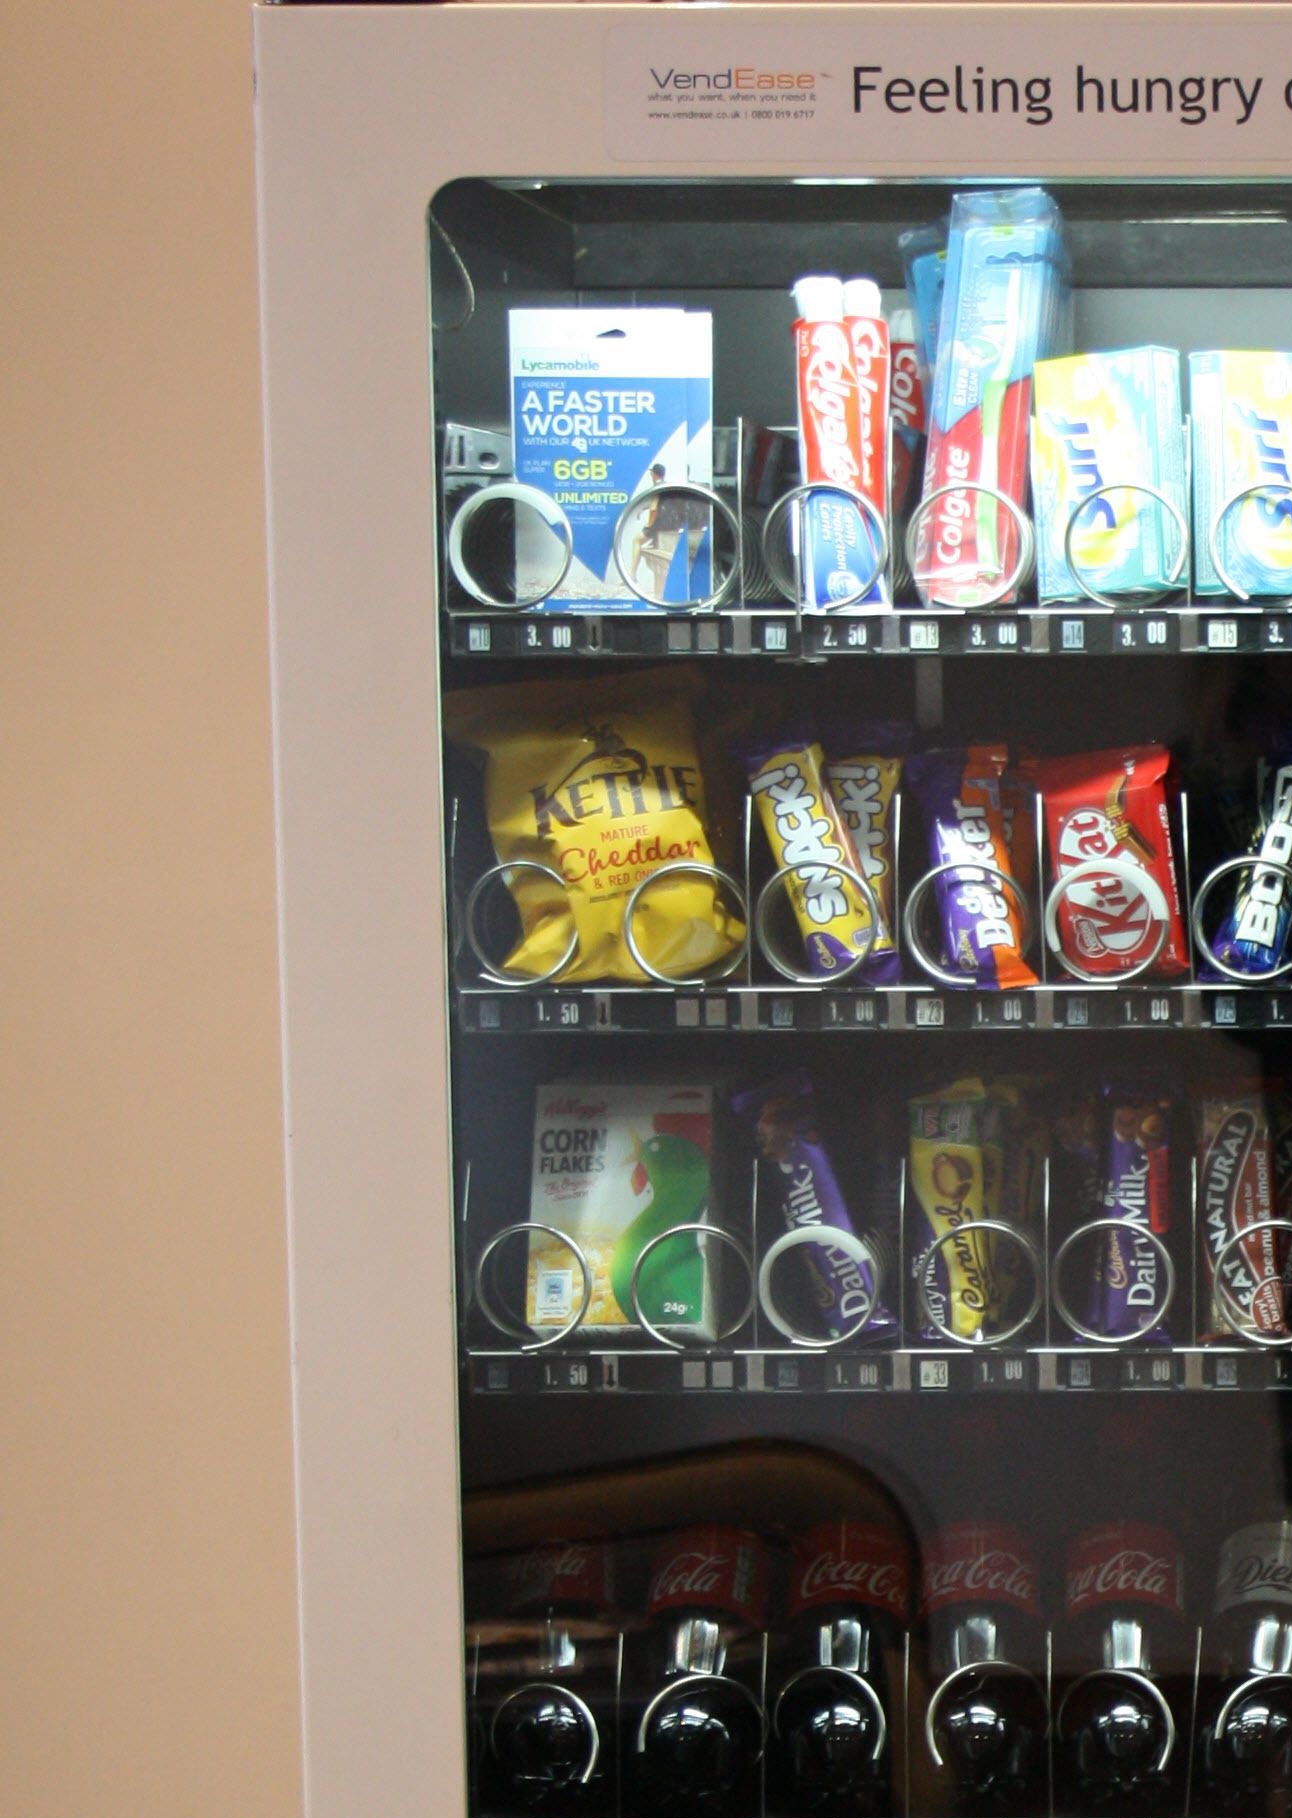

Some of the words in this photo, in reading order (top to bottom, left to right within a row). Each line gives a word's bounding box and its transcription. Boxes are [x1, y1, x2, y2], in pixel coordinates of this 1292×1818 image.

[650, 66, 816, 90] VendEase
[677, 94, 695, 104] you
[729, 92, 756, 102] when
[760, 94, 779, 104] you
[782, 93, 807, 102] need
[851, 64, 1053, 127] Feeling
[1075, 66, 1261, 127] hungry
[521, 358, 600, 373] Lycamobile
[952, 367, 970, 408] Extra
[521, 391, 544, 413] A
[548, 391, 656, 414] FASTER
[808, 324, 860, 486] Colgate
[522, 414, 628, 437] WORLD
[554, 492, 628, 505] UNLIMITED
[936, 446, 972, 566] Colgate
[600, 824, 649, 843] MATURE
[750, 763, 852, 926] SNACK!
[559, 836, 702, 884] Cheddar
[608, 872, 630, 888] RED
[540, 1128, 608, 1156] CORN
[540, 1155, 606, 1176] FLAKES
[1254, 1150, 1269, 1207] almond
[1205, 1121, 1247, 1254] NATURAL
[1222, 1256, 1257, 1306] EAT
